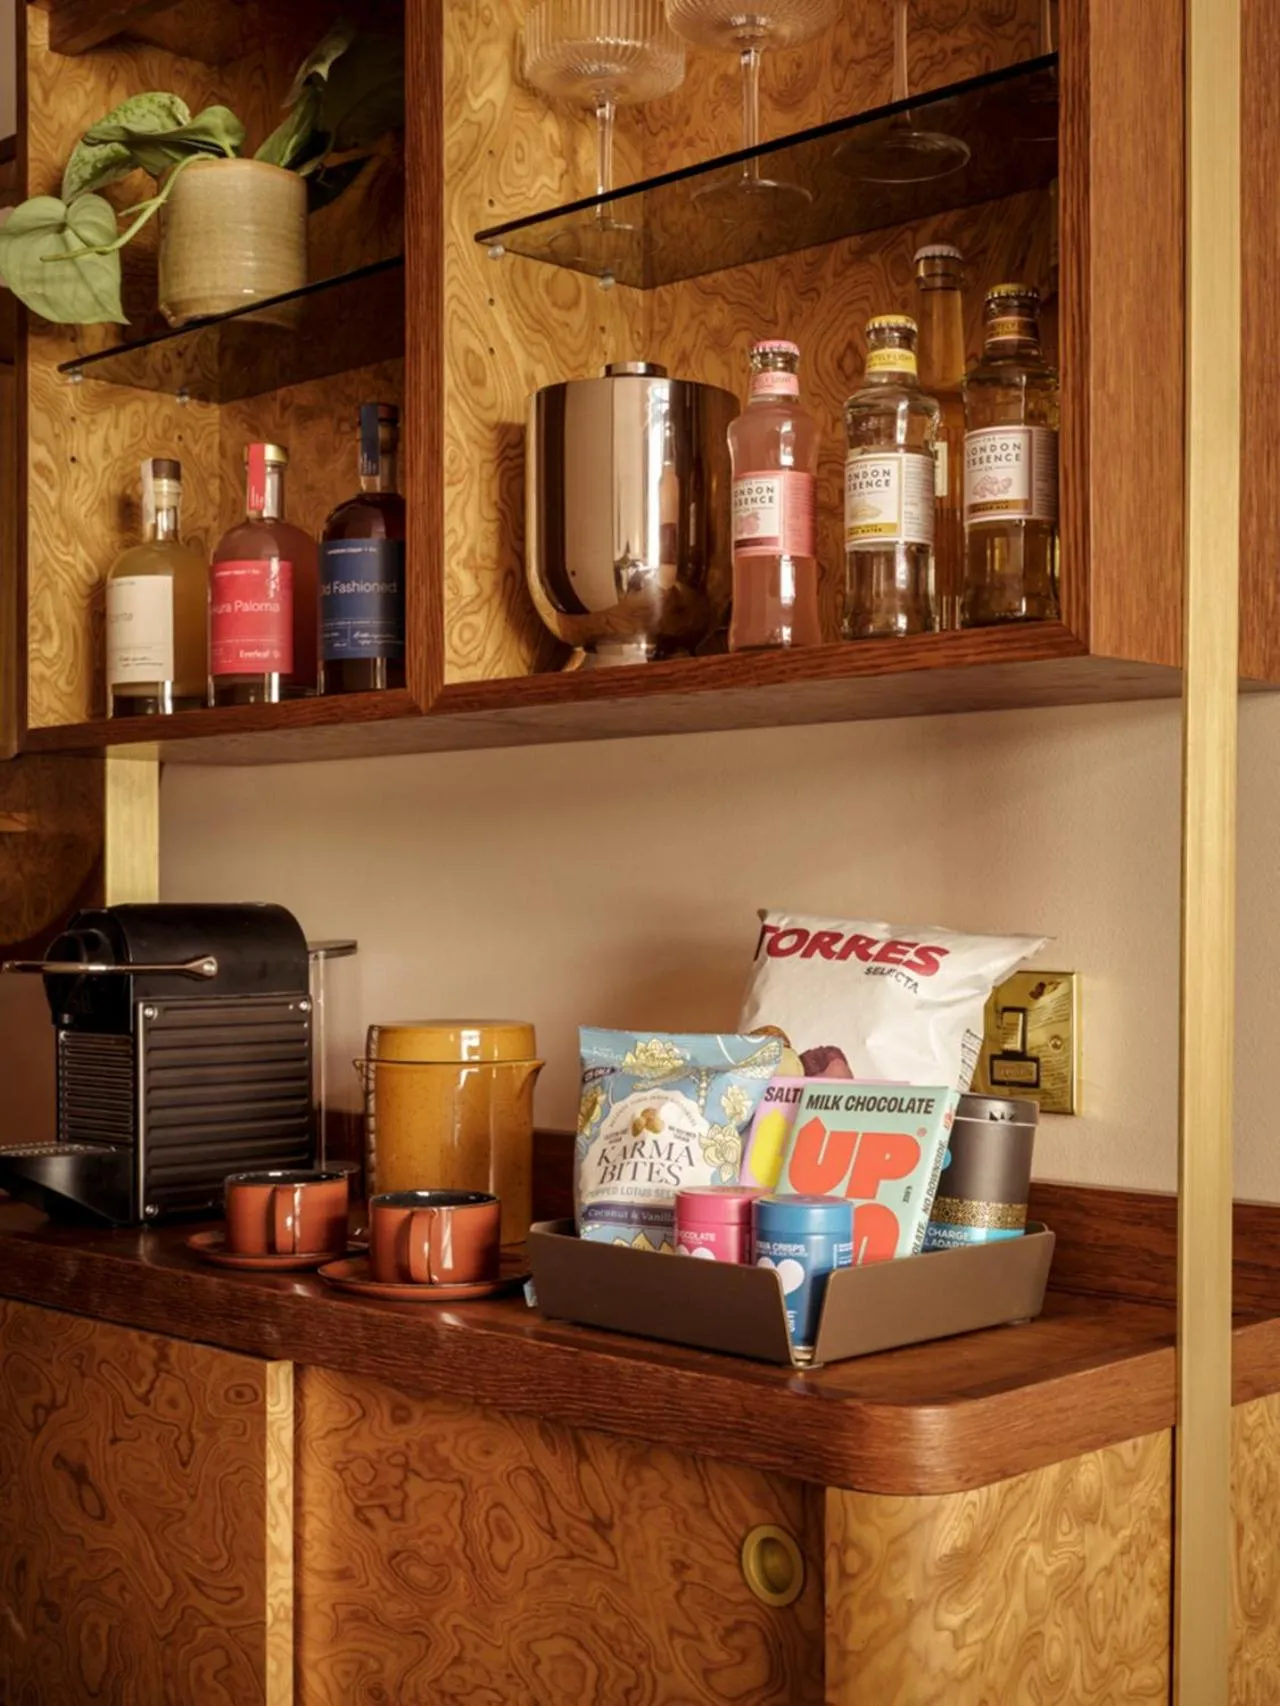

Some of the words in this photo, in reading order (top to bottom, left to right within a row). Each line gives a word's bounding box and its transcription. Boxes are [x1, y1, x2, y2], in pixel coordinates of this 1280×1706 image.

[966, 442, 1021, 457] ONDON
[332, 580, 398, 595] Fashioned
[233, 600, 281, 613] Paloma
[754, 924, 950, 977] TORRES
[864, 965, 920, 995] SELECTA
[805, 1094, 842, 1111] MILK
[844, 1096, 936, 1115] CHOCOLATE
[597, 1138, 695, 1168] KARMA
[788, 1115, 922, 1200] UP
[599, 1161, 682, 1187] BITES
[927, 1227, 969, 1240] CHARGE
